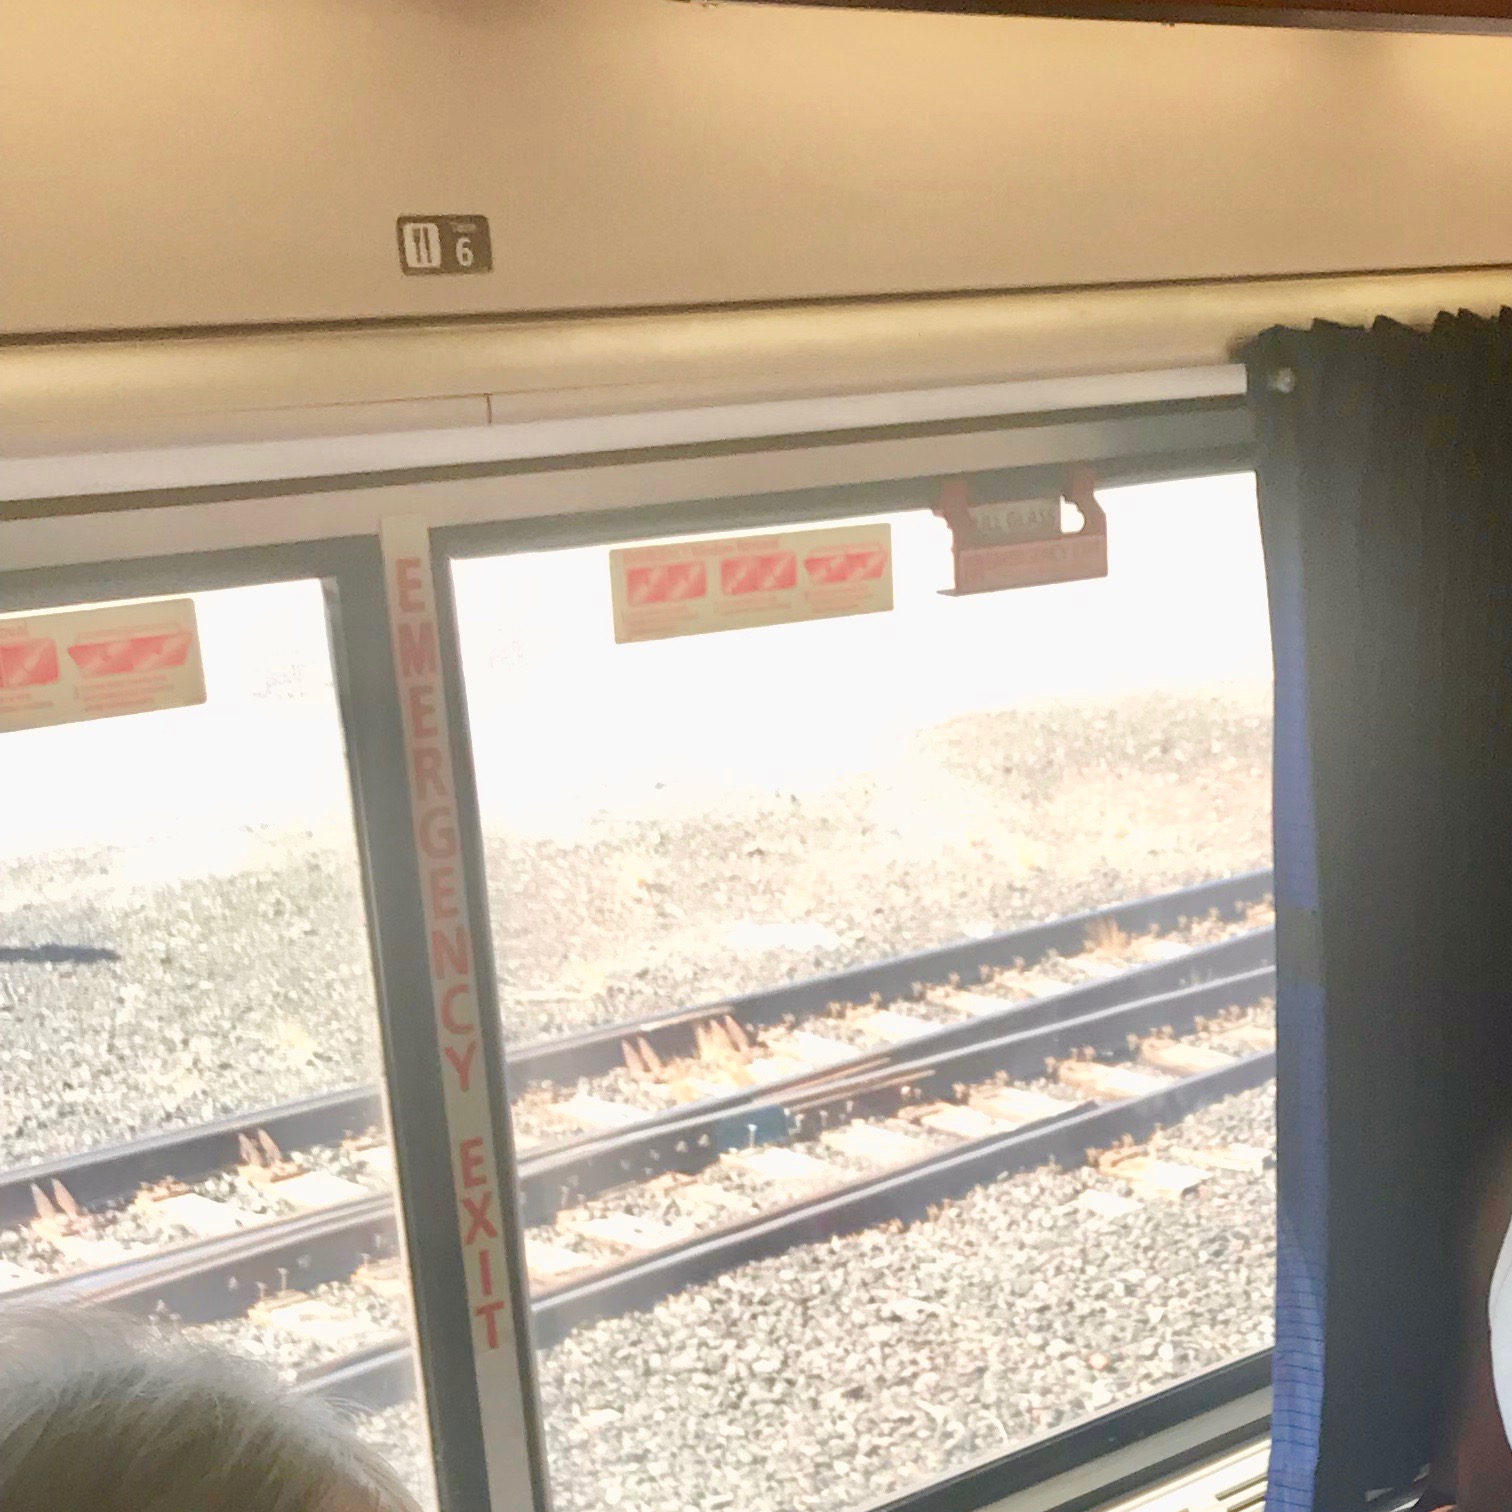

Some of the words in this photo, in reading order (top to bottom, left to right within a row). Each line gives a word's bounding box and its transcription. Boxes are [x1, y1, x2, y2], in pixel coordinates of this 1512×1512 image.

[455, 236, 474, 267] 6
[394, 557, 477, 1092] EMERGENCY
[458, 1137, 505, 1349] EXIT
